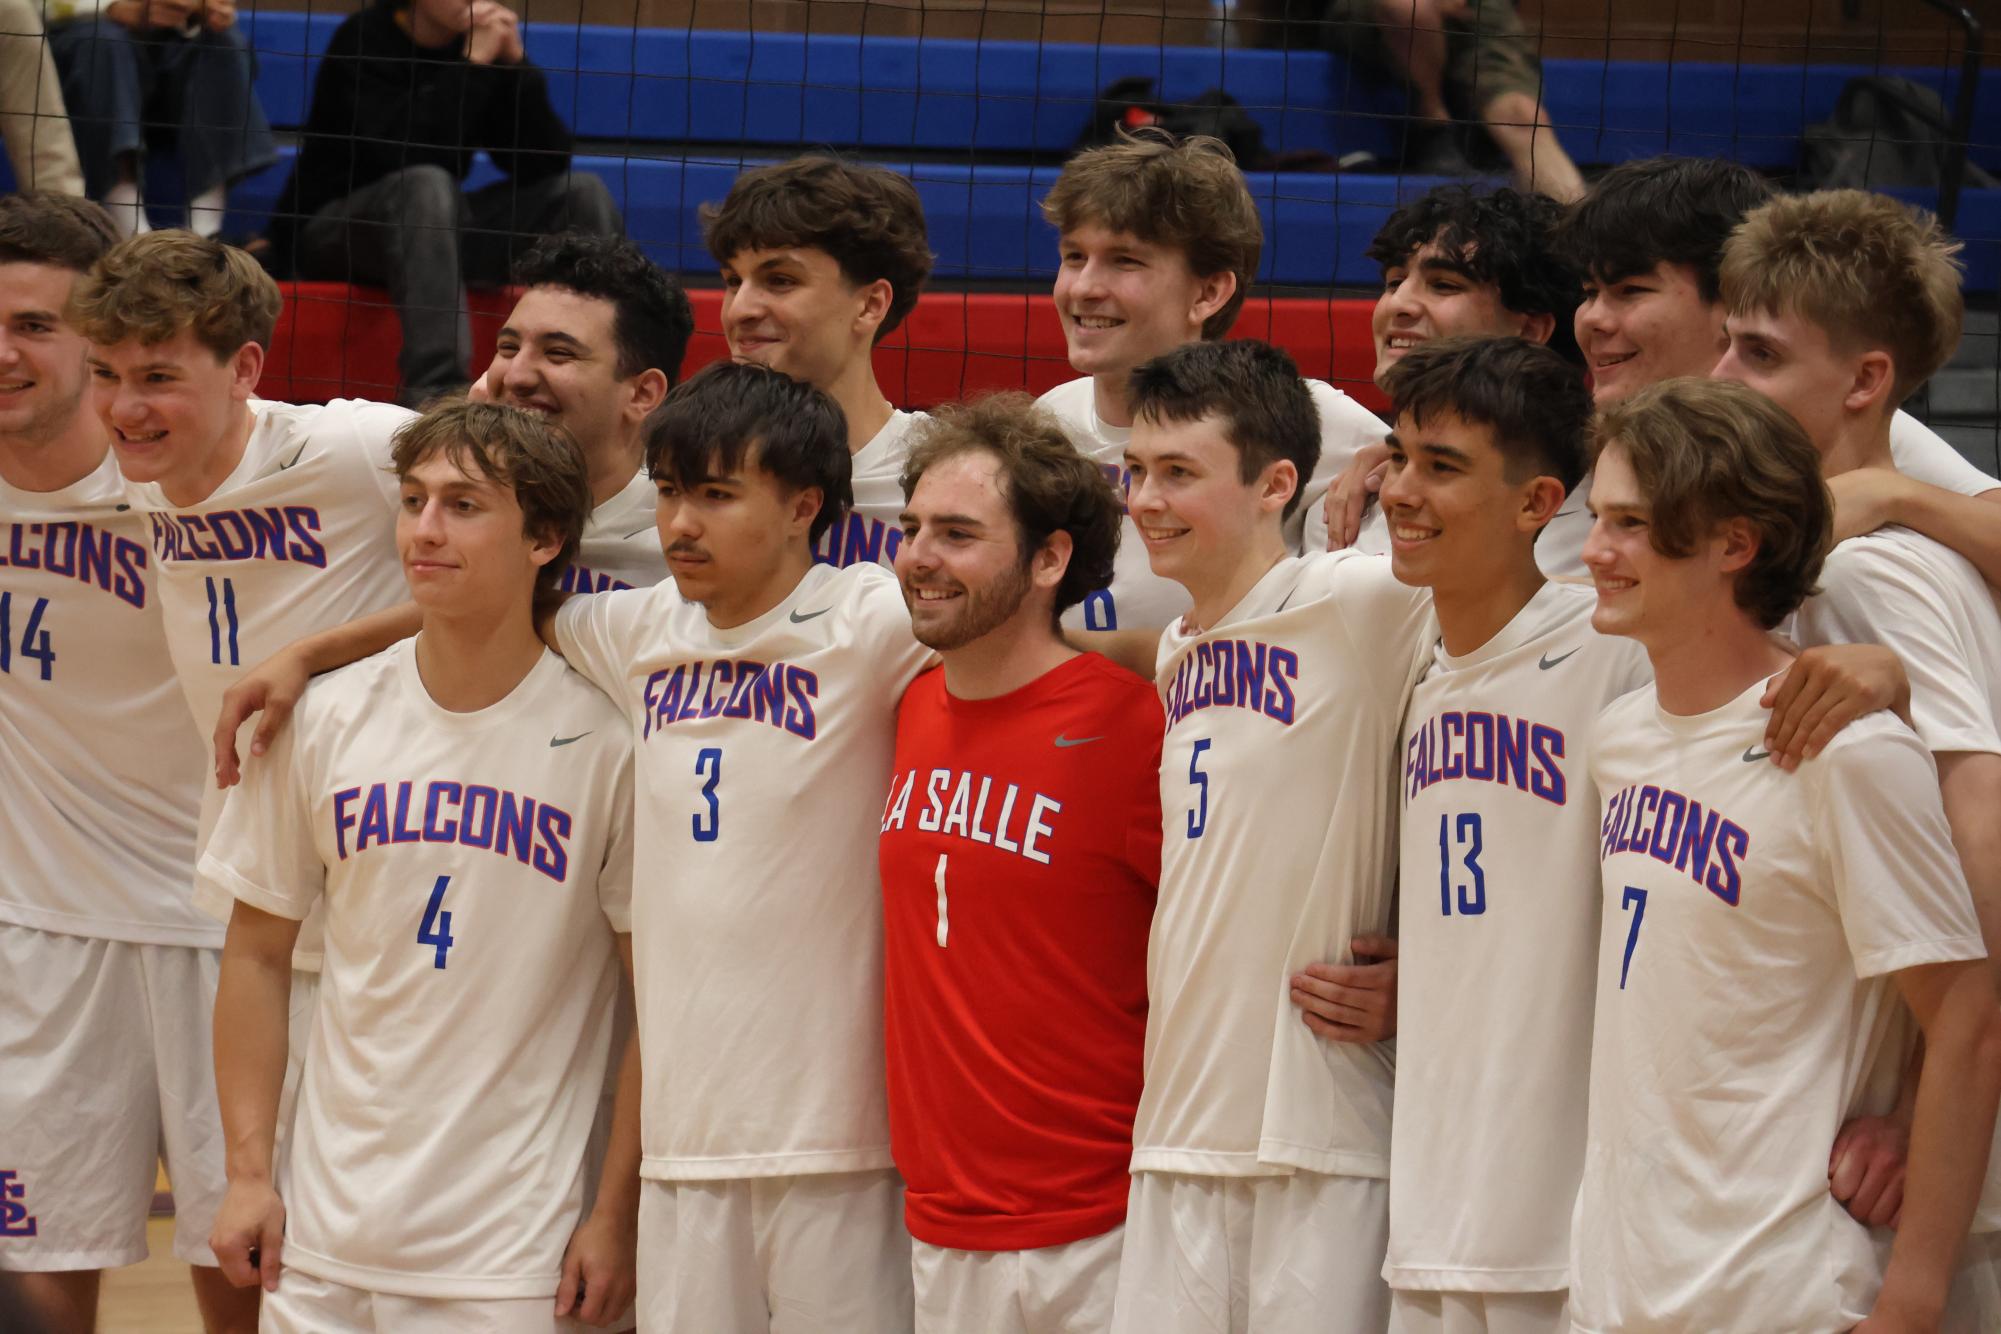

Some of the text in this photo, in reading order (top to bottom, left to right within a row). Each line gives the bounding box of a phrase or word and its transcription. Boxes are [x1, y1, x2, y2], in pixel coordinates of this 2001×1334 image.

[0, 520, 147, 610] CONS
[149, 505, 328, 569] FALCONS
[0, 591, 56, 681] 14
[206, 576, 240, 666] 11
[644, 659, 819, 743] FALCONS
[1166, 639, 1299, 736] FALCONS
[692, 747, 723, 842] 3
[1187, 737, 1212, 839] 5
[1405, 711, 1567, 811] FALCONS
[333, 780, 572, 883] FALCONS
[918, 767, 1062, 866] SALLE
[1439, 812, 1487, 916] 13
[1600, 784, 1750, 907] FALCONS
[416, 875, 454, 969] 4
[934, 853, 949, 948] 1
[1621, 885, 1648, 990] 7
